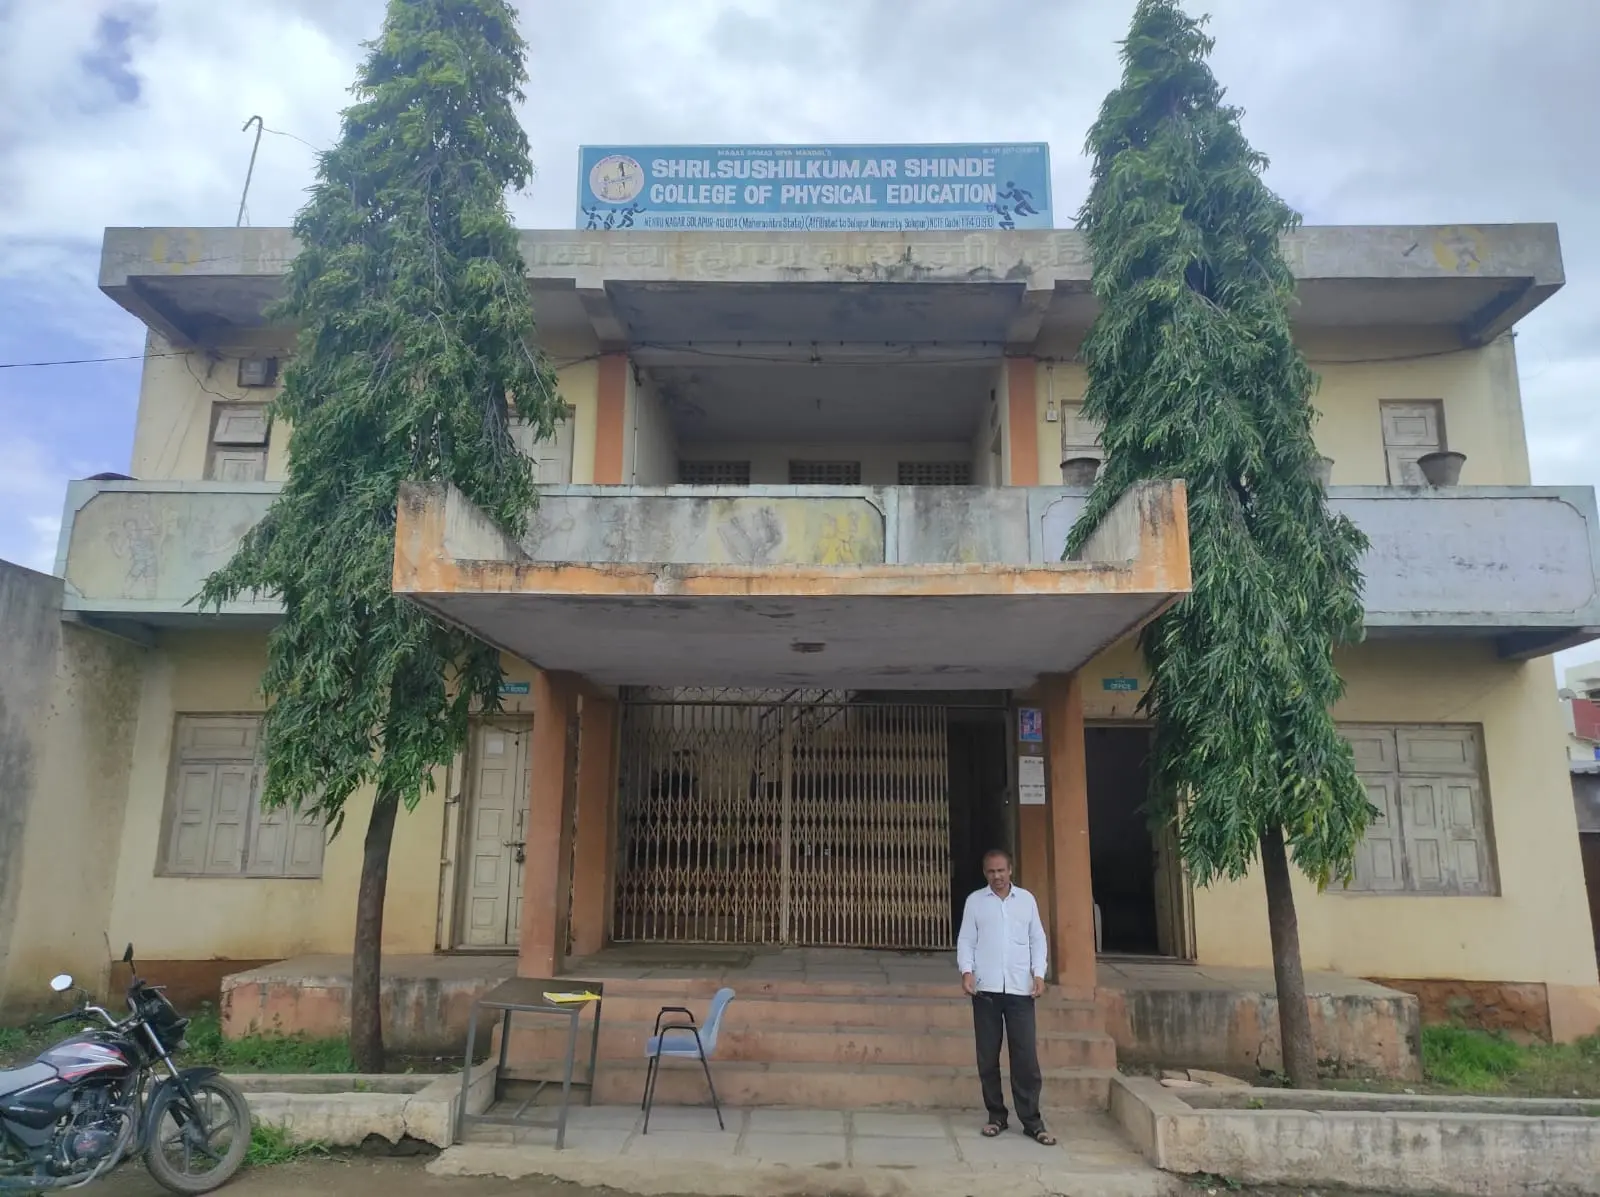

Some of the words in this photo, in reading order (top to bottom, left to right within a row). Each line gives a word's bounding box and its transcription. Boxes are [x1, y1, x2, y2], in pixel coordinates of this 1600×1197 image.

[651, 158, 897, 179] SHRI.SUSHILKUMAR
[904, 158, 995, 178] SHINDE
[650, 184, 737, 205] COLLEGE
[744, 185, 773, 205] OF
[780, 184, 878, 205] PHYSICAL
[886, 184, 997, 205] EDUCATION
